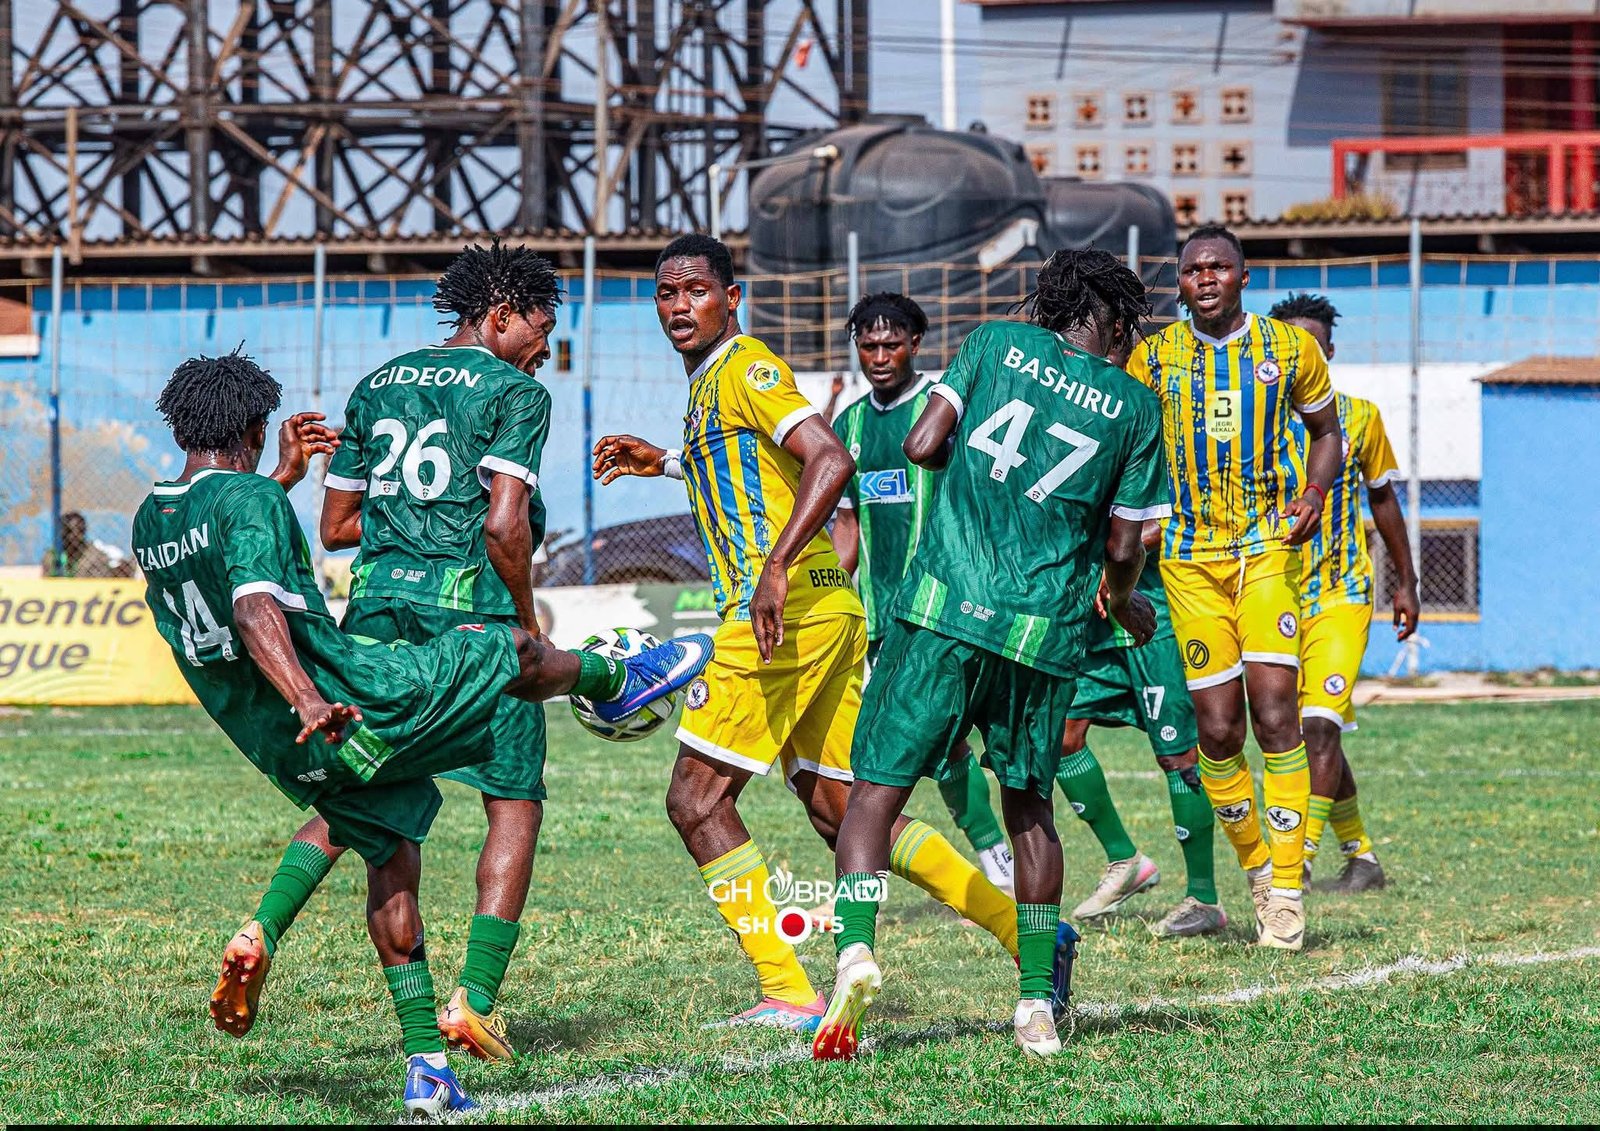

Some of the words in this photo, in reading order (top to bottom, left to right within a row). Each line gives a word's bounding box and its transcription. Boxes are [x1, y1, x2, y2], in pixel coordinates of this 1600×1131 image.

[369, 366, 482, 389] GIDEON
[1003, 345, 1124, 419] BASHIRU
[368, 418, 451, 501] 26
[966, 398, 1100, 503] 47
[859, 468, 908, 498] KGI
[136, 523, 209, 571] ZAIDAN
[162, 579, 239, 667] 14
[1142, 685, 1165, 720] 17
